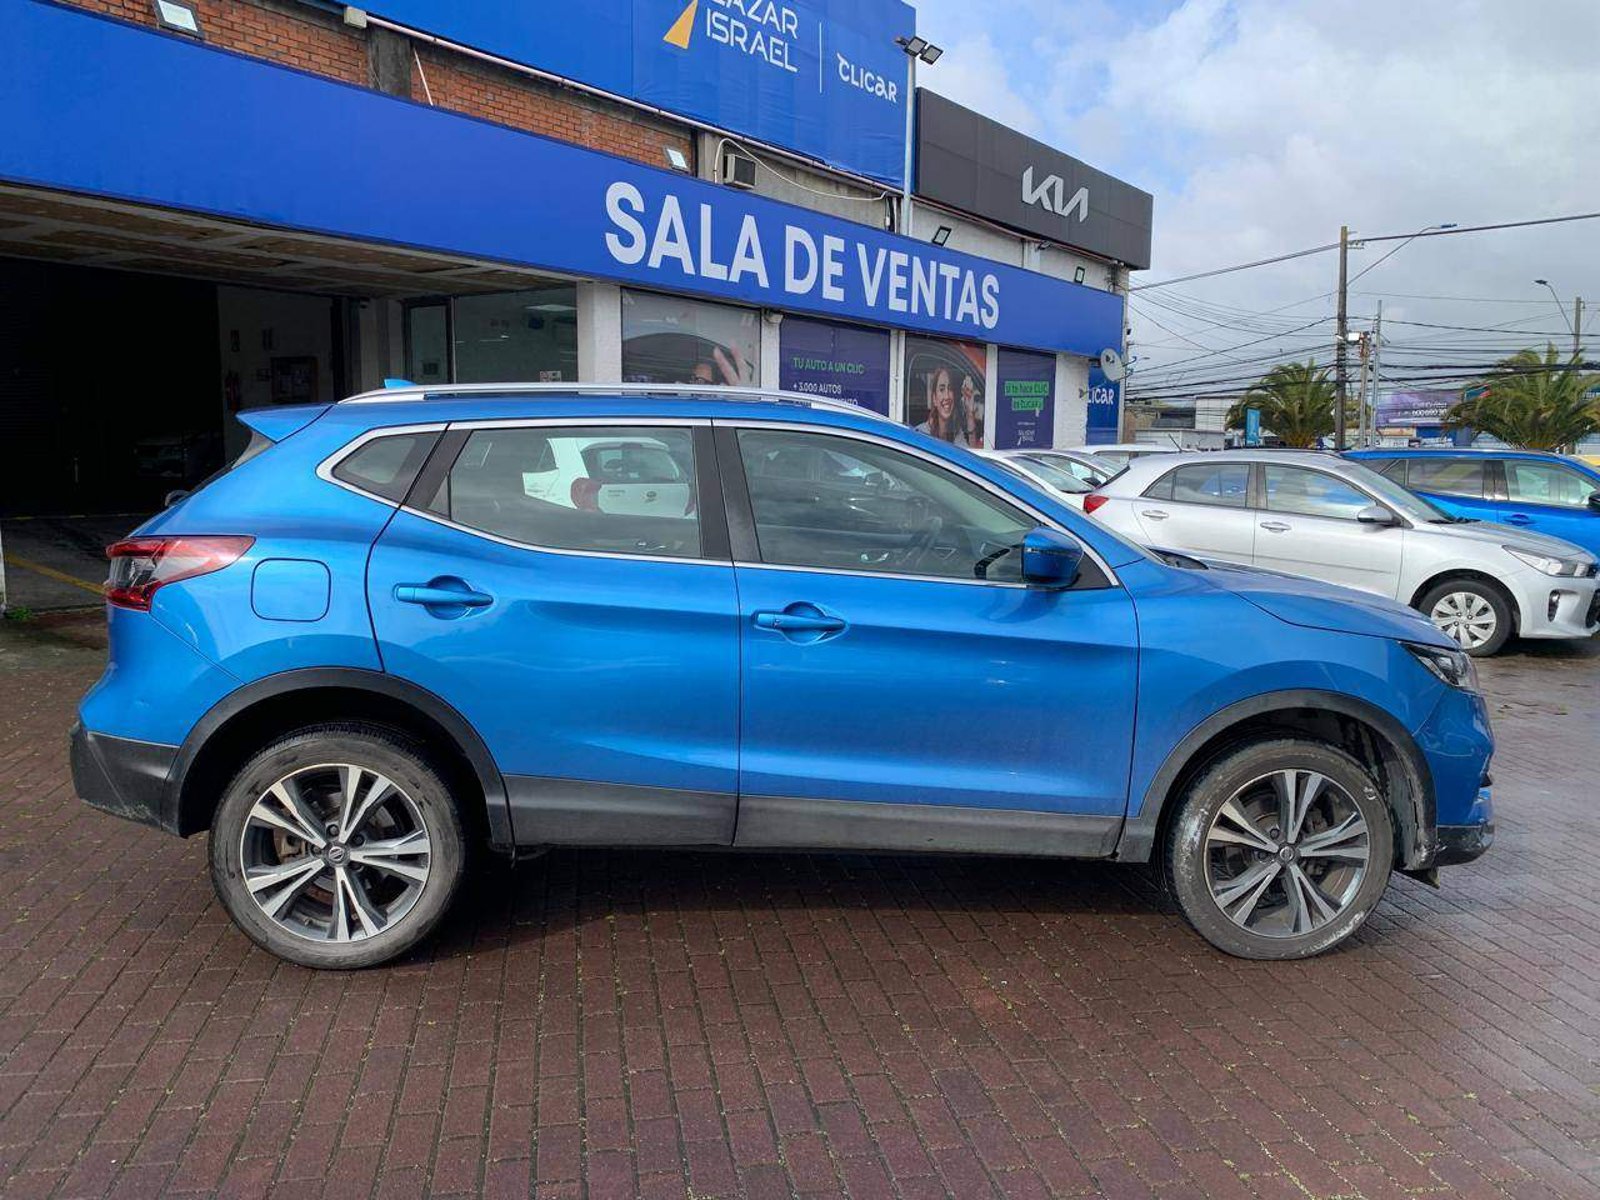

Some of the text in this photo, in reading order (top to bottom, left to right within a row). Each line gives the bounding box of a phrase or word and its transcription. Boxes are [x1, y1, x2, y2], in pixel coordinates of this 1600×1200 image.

[706, 8, 798, 72] ISRAEL
[1022, 165, 1089, 222] KIA
[605, 182, 1000, 329] SALA DE VENTAS
[793, 357, 804, 369] TU
[804, 359, 827, 372] AUTO
[818, 382, 842, 394] AUTOS
